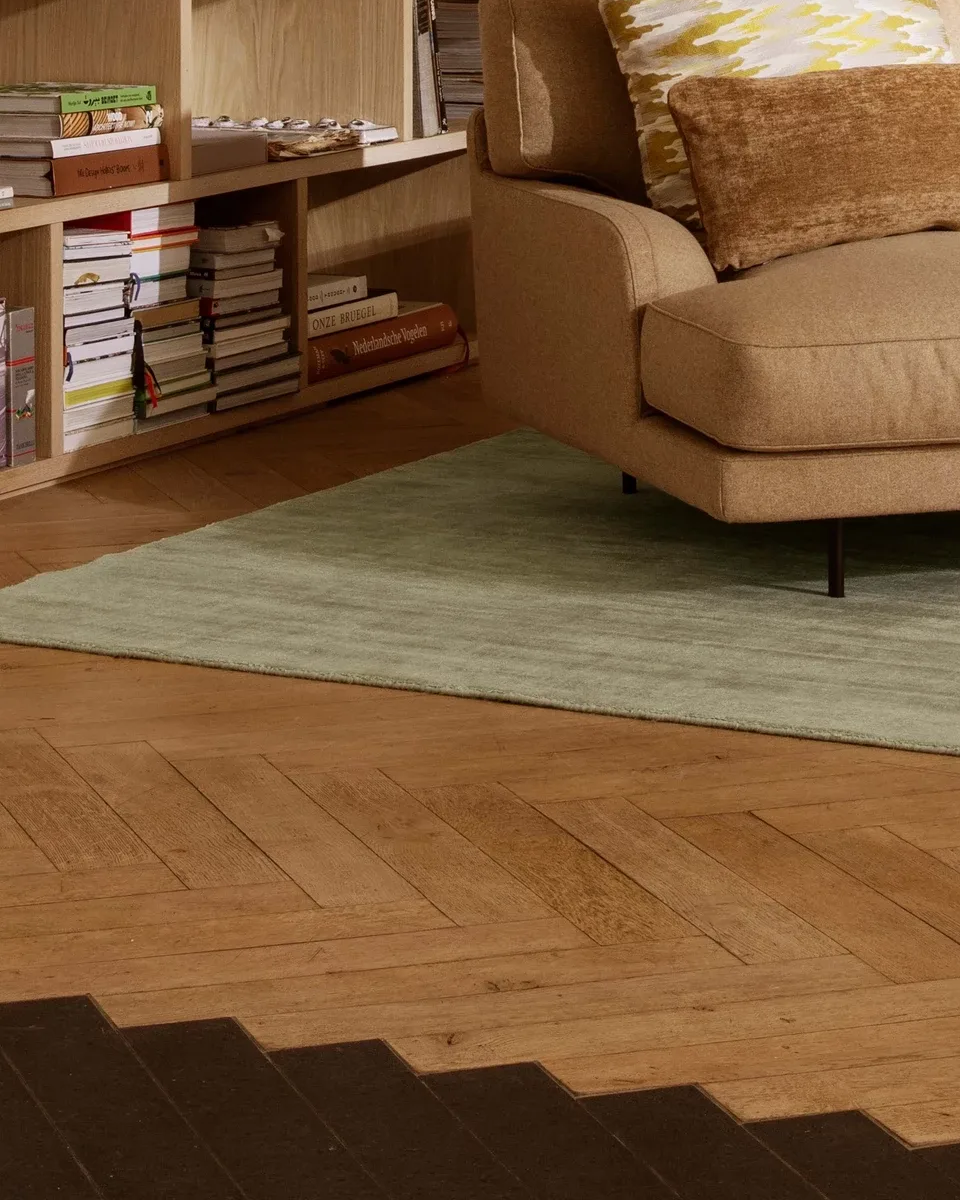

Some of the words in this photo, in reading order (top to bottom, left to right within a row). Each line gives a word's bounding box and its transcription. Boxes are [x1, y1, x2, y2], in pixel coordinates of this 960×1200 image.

[312, 315, 336, 330] ONZE
[340, 305, 376, 325] BRUEGEL
[352, 330, 402, 356] Nederlandsche
[400, 323, 428, 345] Vogelen
